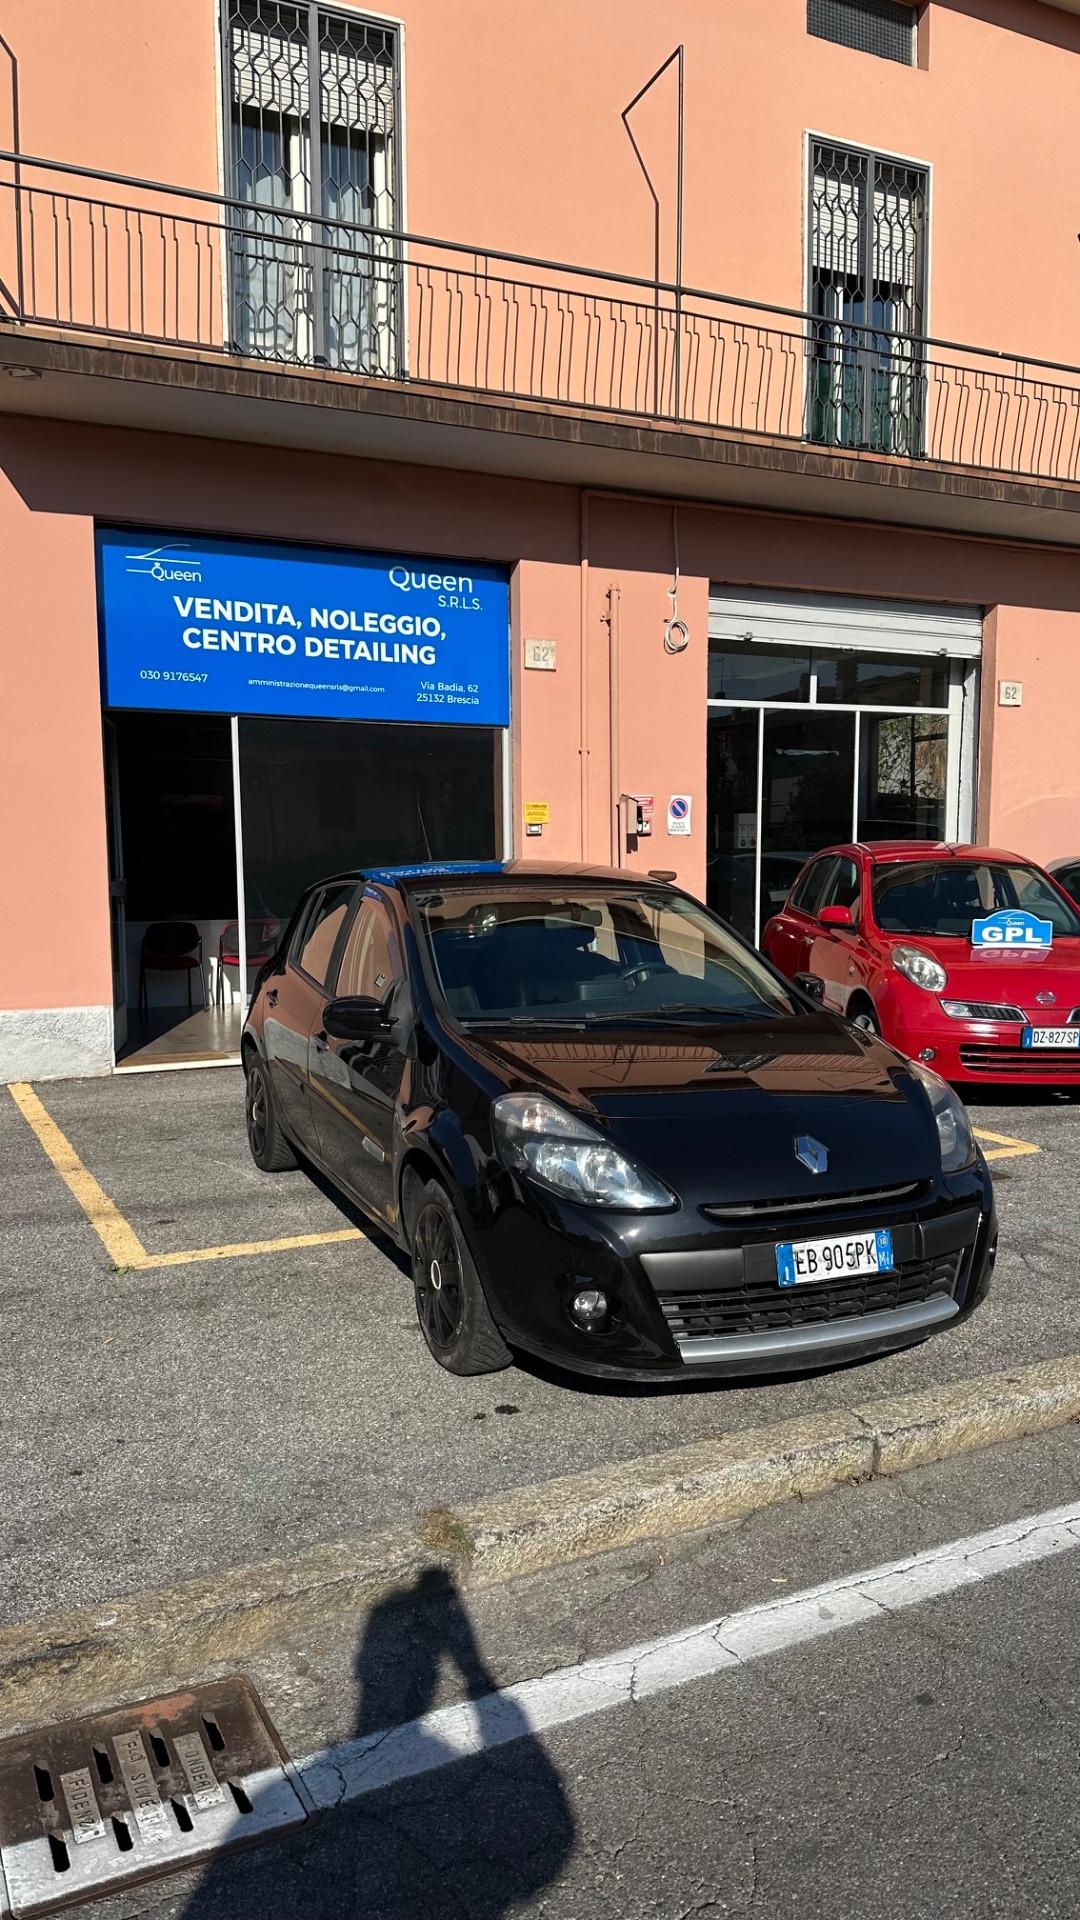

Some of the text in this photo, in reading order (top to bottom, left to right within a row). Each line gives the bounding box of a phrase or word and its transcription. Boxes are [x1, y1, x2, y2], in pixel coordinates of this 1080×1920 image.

[151, 563, 202, 582] Queen
[388, 566, 473, 593] Queen
[438, 594, 483, 611] S.R.L.S.
[172, 595, 446, 641] VENDITA, NOLEGGIO,
[182, 627, 436, 666] CENTRO DETAILING
[139, 669, 208, 683] 030 9176547
[420, 680, 479, 694] Via Badia, 62
[1005, 686, 1017, 700] 62
[416, 692, 480, 705] 25132 Brescia
[981, 926, 1043, 942] GPL
[795, 1248, 818, 1275] EB
[822, 1239, 877, 1271] 905PK
